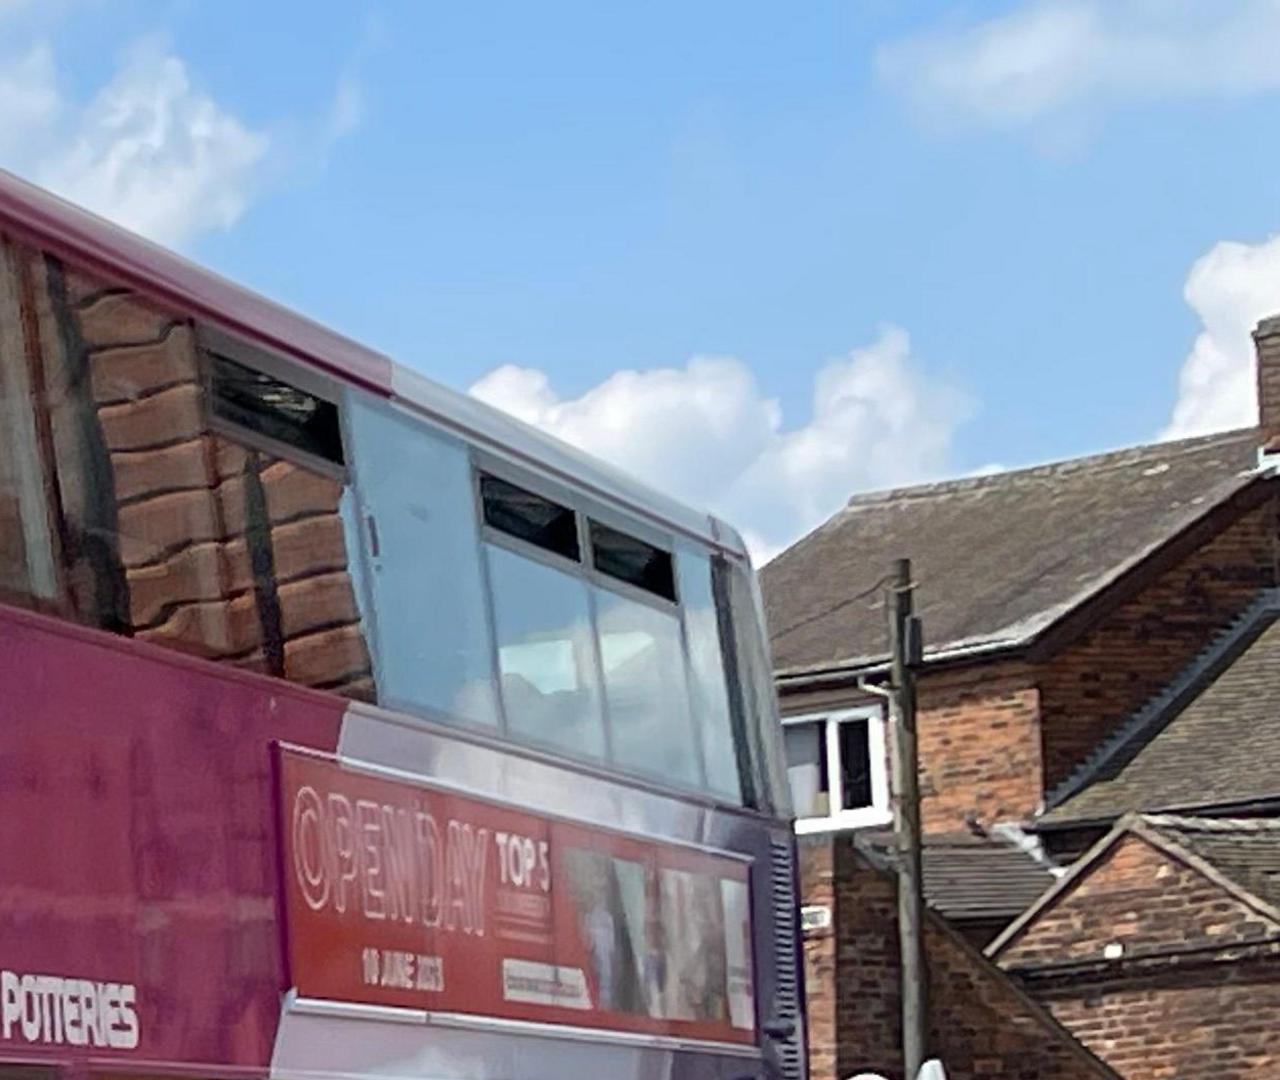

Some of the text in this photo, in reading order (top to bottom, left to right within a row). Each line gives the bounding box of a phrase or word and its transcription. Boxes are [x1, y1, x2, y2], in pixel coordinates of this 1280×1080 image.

[293, 786, 416, 923] OPEN
[415, 811, 488, 937] DAY
[495, 831, 536, 887] TOP
[0, 970, 140, 1049] POTTERIES
